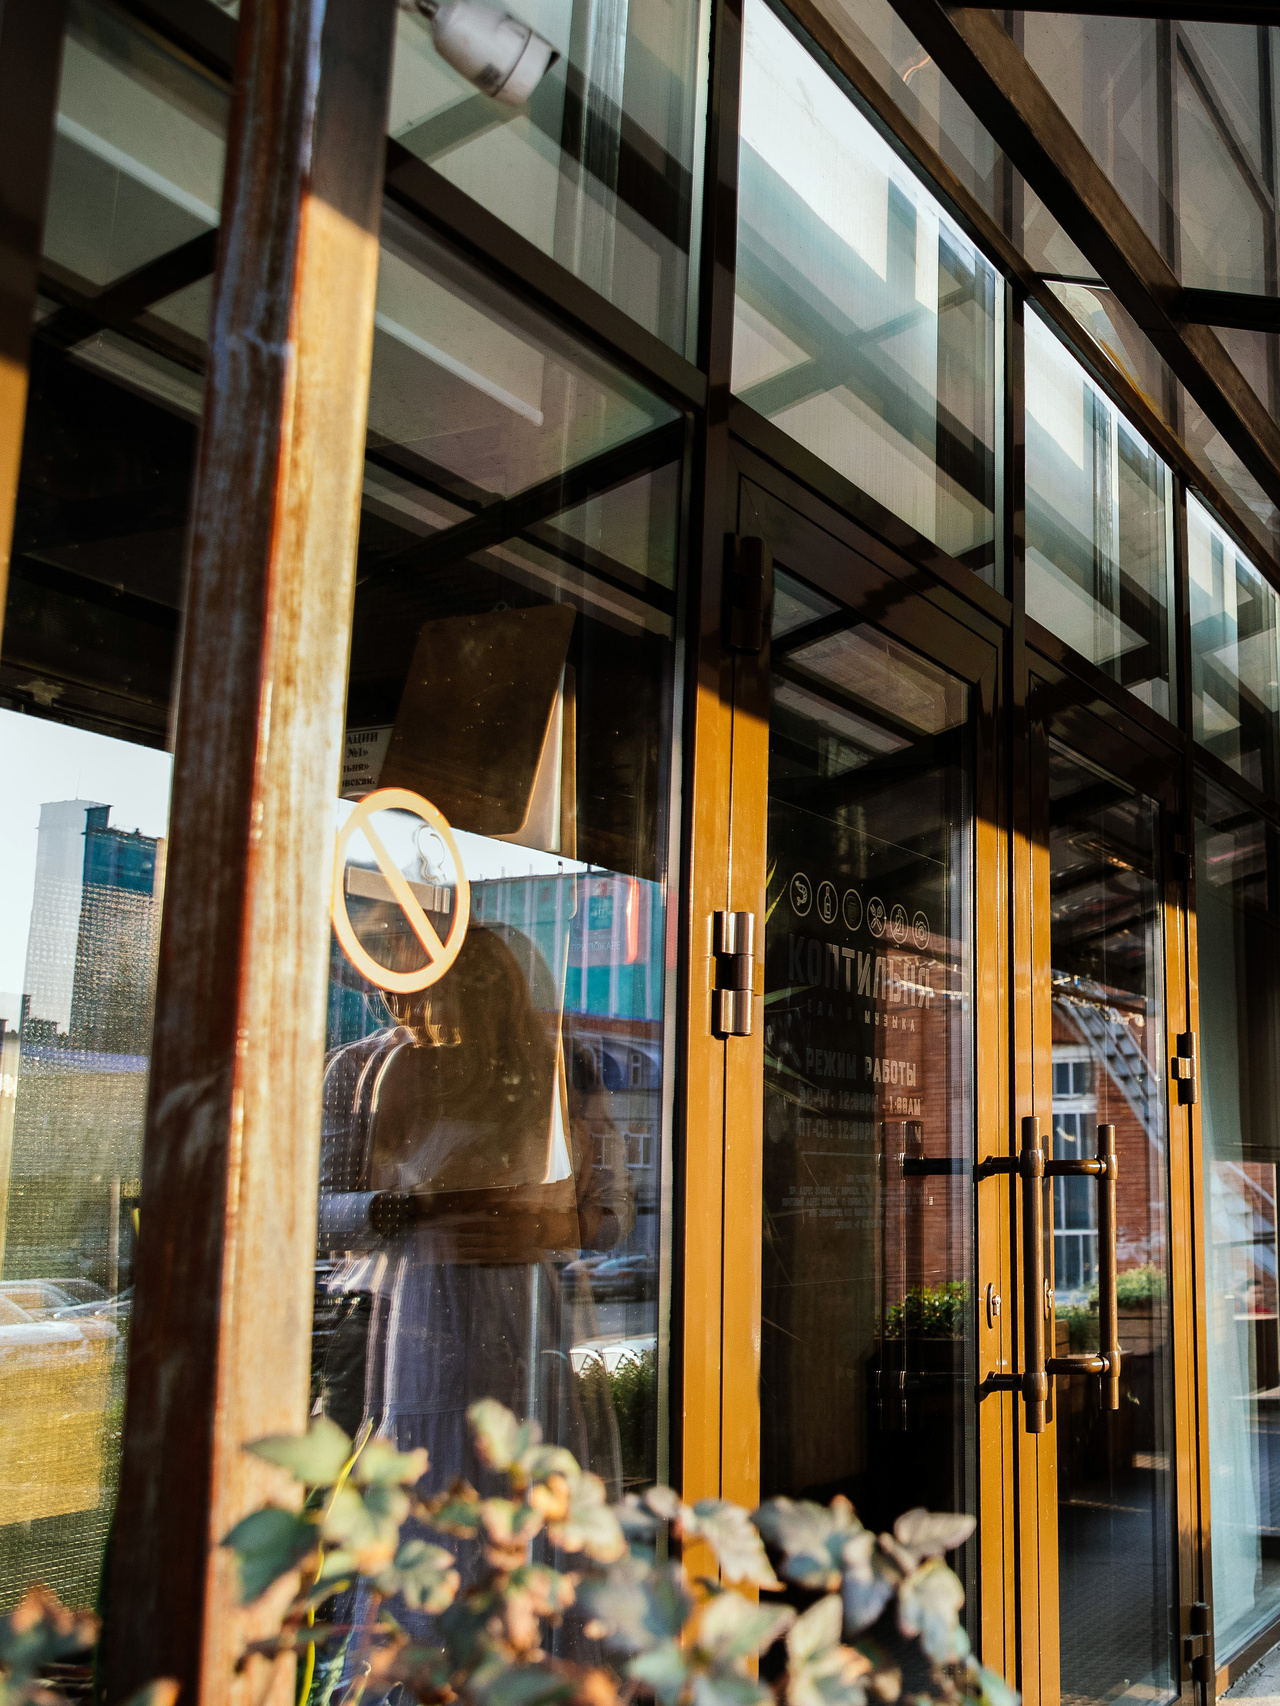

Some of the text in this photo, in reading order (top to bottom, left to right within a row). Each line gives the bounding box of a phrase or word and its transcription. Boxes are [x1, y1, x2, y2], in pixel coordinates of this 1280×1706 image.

[788, 933, 931, 1010] КОПТИЛЬНЯ
[864, 1011, 916, 1032] МУЗЫКА
[805, 1048, 917, 1087] РЕЖИМ РАБОТЫ
[888, 1095, 921, 1116] 1:00AM
